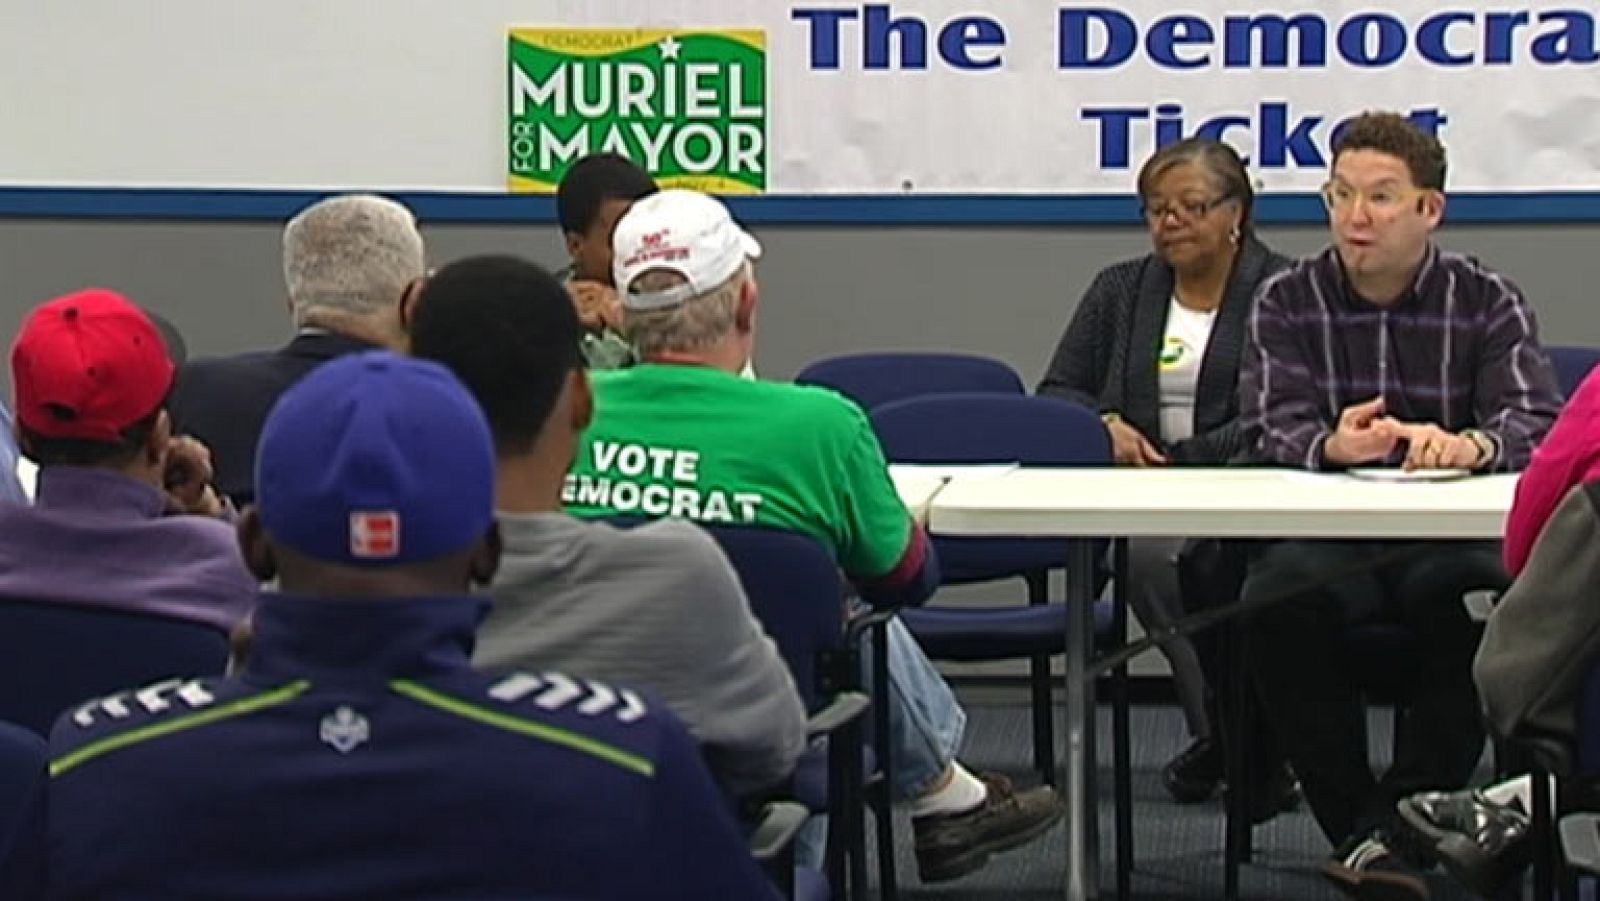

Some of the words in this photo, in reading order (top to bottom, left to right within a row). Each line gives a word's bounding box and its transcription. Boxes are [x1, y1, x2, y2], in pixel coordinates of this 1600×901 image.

[791, 4, 1006, 70] The
[1058, 7, 1600, 70] Democra
[512, 62, 763, 118] MURIEL
[512, 121, 535, 172] FOR
[539, 122, 764, 173] MAYOR
[1077, 102, 1447, 168] Tick
[592, 440, 699, 482] VOTE
